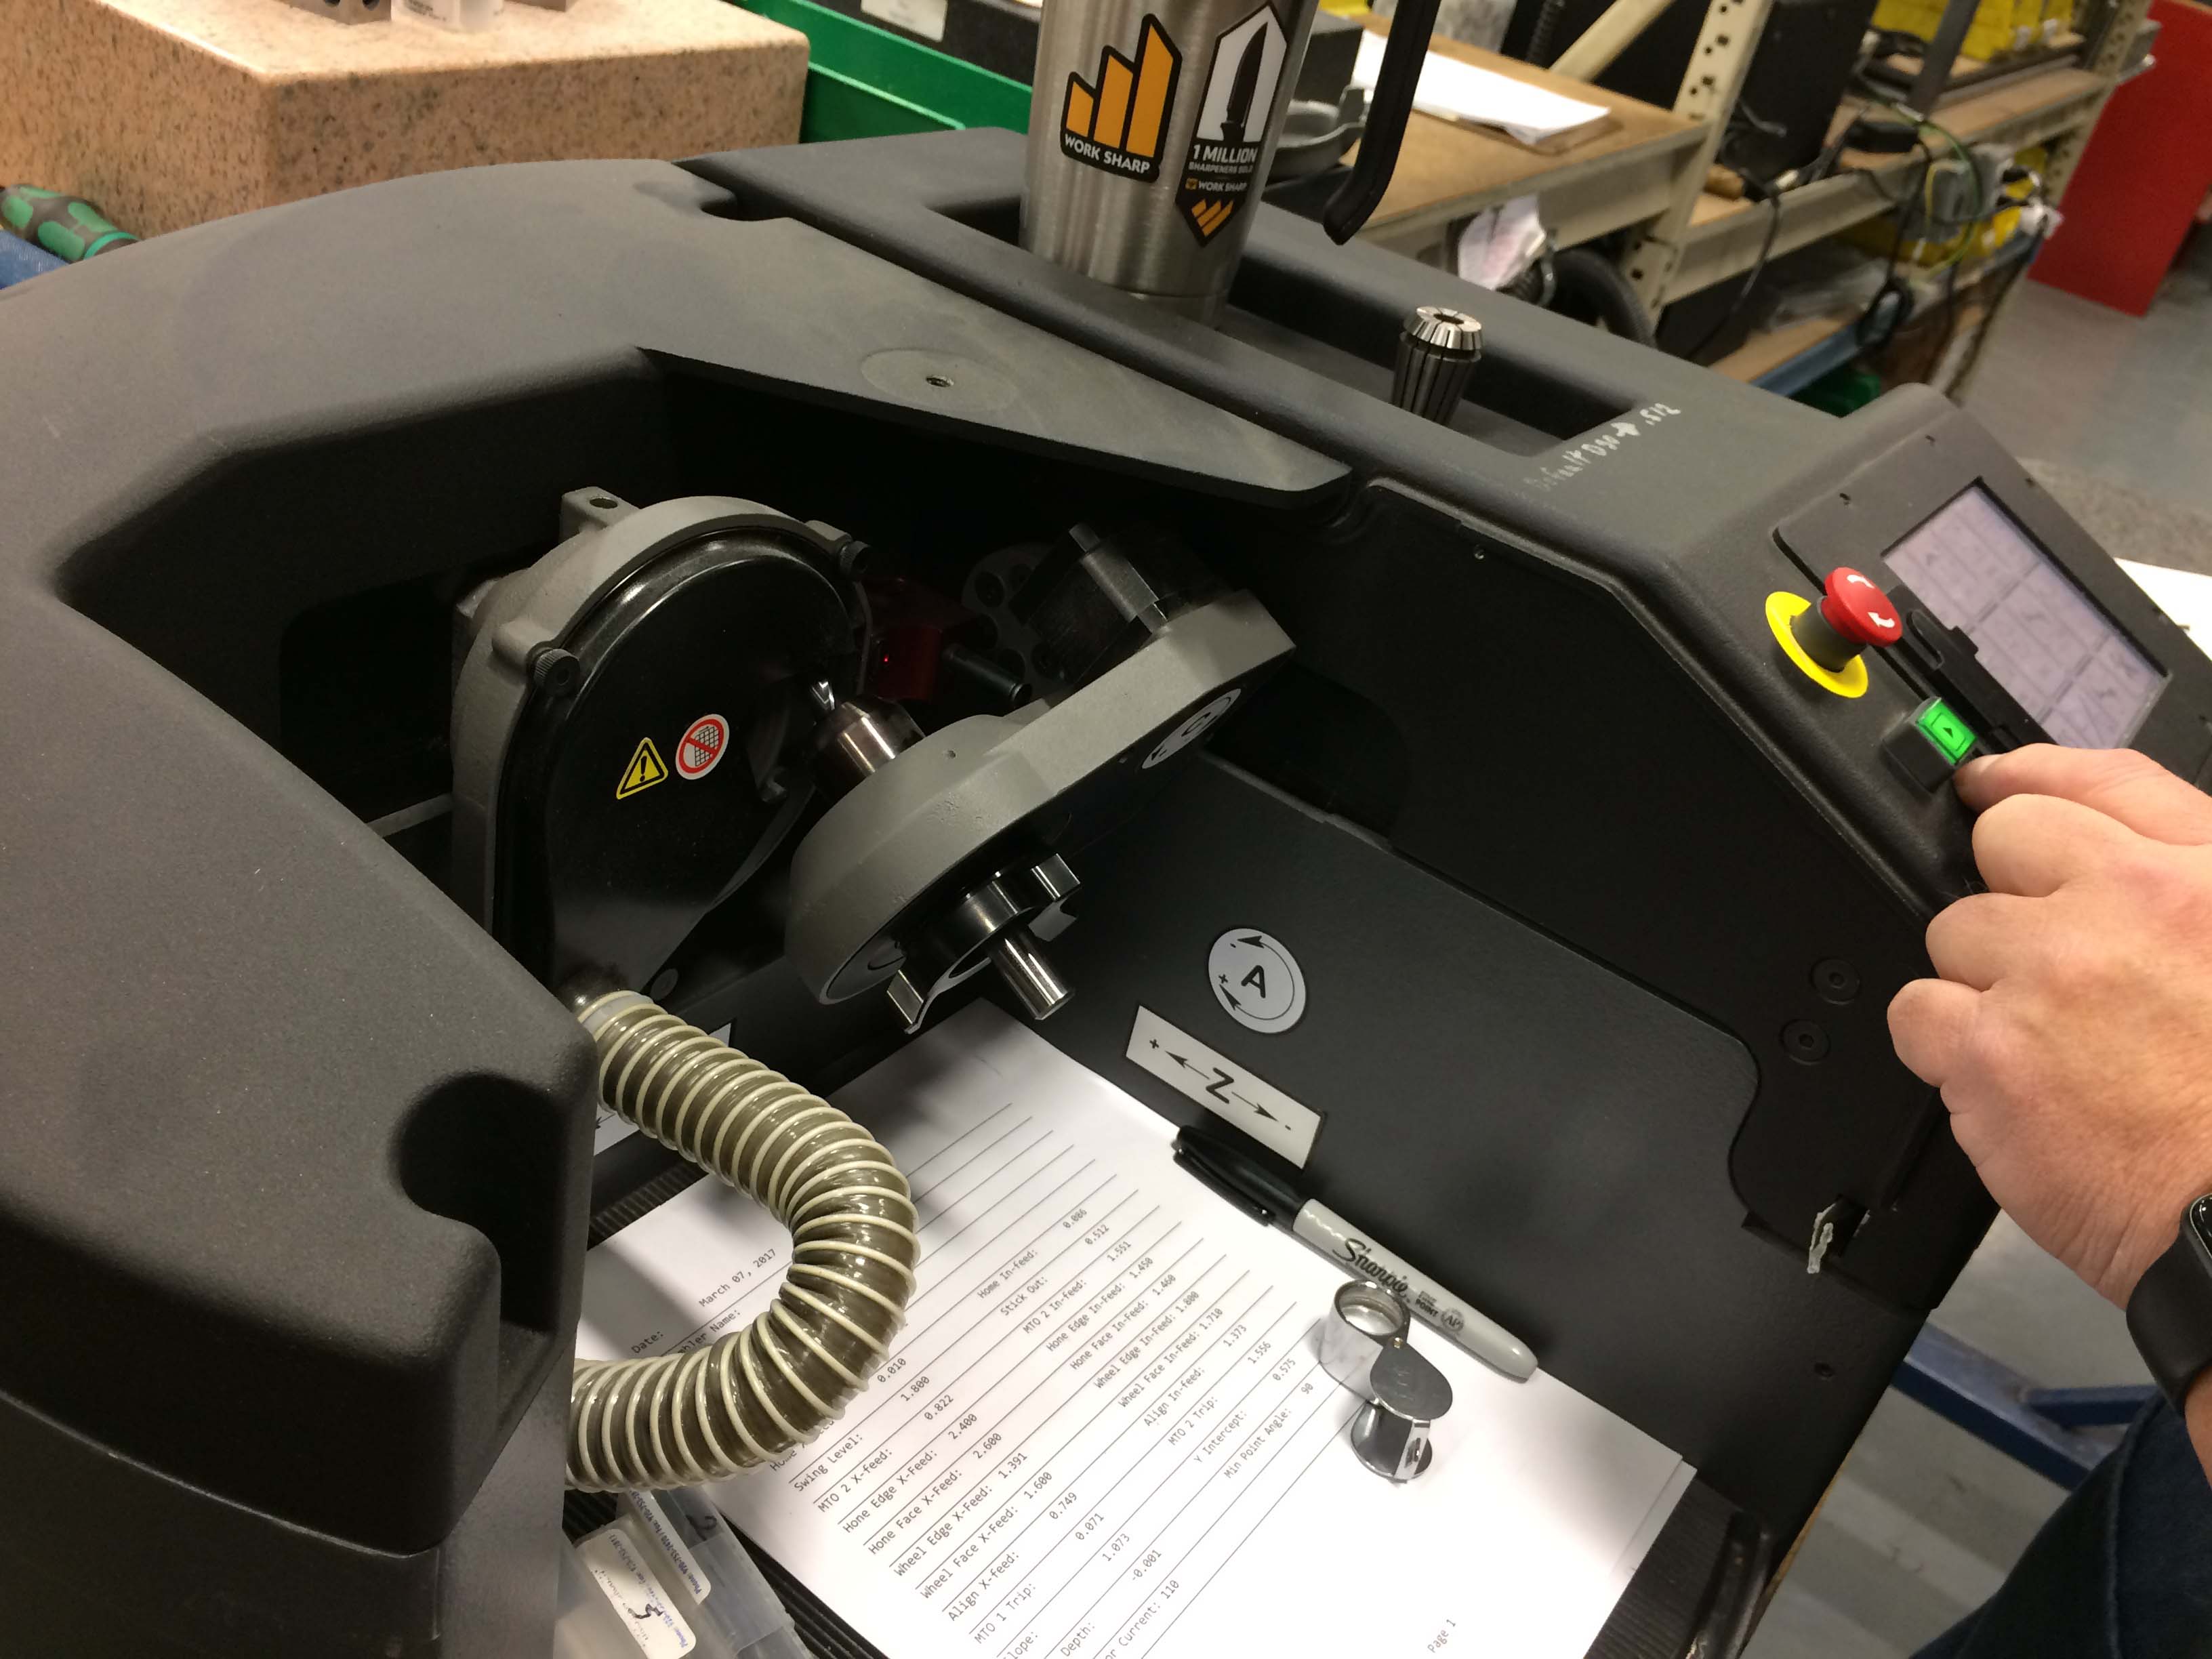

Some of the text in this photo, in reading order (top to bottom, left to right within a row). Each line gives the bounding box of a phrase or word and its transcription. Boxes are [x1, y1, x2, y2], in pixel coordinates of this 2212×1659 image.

[1065, 134, 1150, 174] WORK SHARP
[1193, 144, 1258, 163] 1 MILLION
[1198, 180, 1225, 191] WORK
[1241, 964, 1266, 998] A
[1206, 1067, 1235, 1104] Z
[631, 1248, 776, 1354] Date: March 07, 2017
[977, 1208, 1087, 1299] Home In-feed: 0.086
[1000, 1224, 1109, 1316] Stick Out: 0.512
[1022, 1241, 1132, 1334] MTO 2 In-feed: 1.551
[1332, 1238, 1408, 1298] Sharpie
[710, 1309, 741, 1332] Name:
[1046, 1256, 1153, 1352] Hone Edge In-Feed: 1.450
[1069, 1274, 1176, 1370] Hone Face In-Feed: 1.460
[1093, 1291, 1200, 1389] Wheel Edge In-Feed: 1.800
[1415, 1298, 1439, 1317] POINT
[877, 1357, 907, 1383] 0.010
[900, 1376, 930, 1401] 1.800
[1118, 1308, 1223, 1408] Wheel Face In-Feed: 1.710
[1143, 1324, 1247, 1427] Align In-feed: 1.373
[1168, 1340, 1271, 1446] MTO 2 Trip: 1.556
[817, 1394, 954, 1513] MTO 2 X-feed: 0.822
[1193, 1358, 1296, 1464] Y Intercept: 0.575
[1223, 1382, 1314, 1479] Min Point Angle: 90
[794, 1464, 828, 1491] Swing
[827, 1433, 863, 1463] Level:
[842, 1414, 977, 1533] Hone Edge X-Feed: 2.400
[868, 1433, 1002, 1555] Hone Face X-Feed: 2.600
[893, 1452, 1027, 1576] Wheel Edge X-Feed: 1.391
[920, 1471, 1052, 1599] Wheel Face X-Feed: 1.600
[947, 1492, 1078, 1621] Align X-feed: 0.749
[974, 1513, 1105, 1644] MTO 1 Trip: 0.071
[1004, 1533, 1130, 1659] lope: 1.073
[1060, 1549, 1162, 1656] Depth: -0.001
[1118, 1601, 1161, 1647] Current:
[1160, 1580, 1179, 1599] 110
[1427, 1619, 1456, 1653] Page 1
